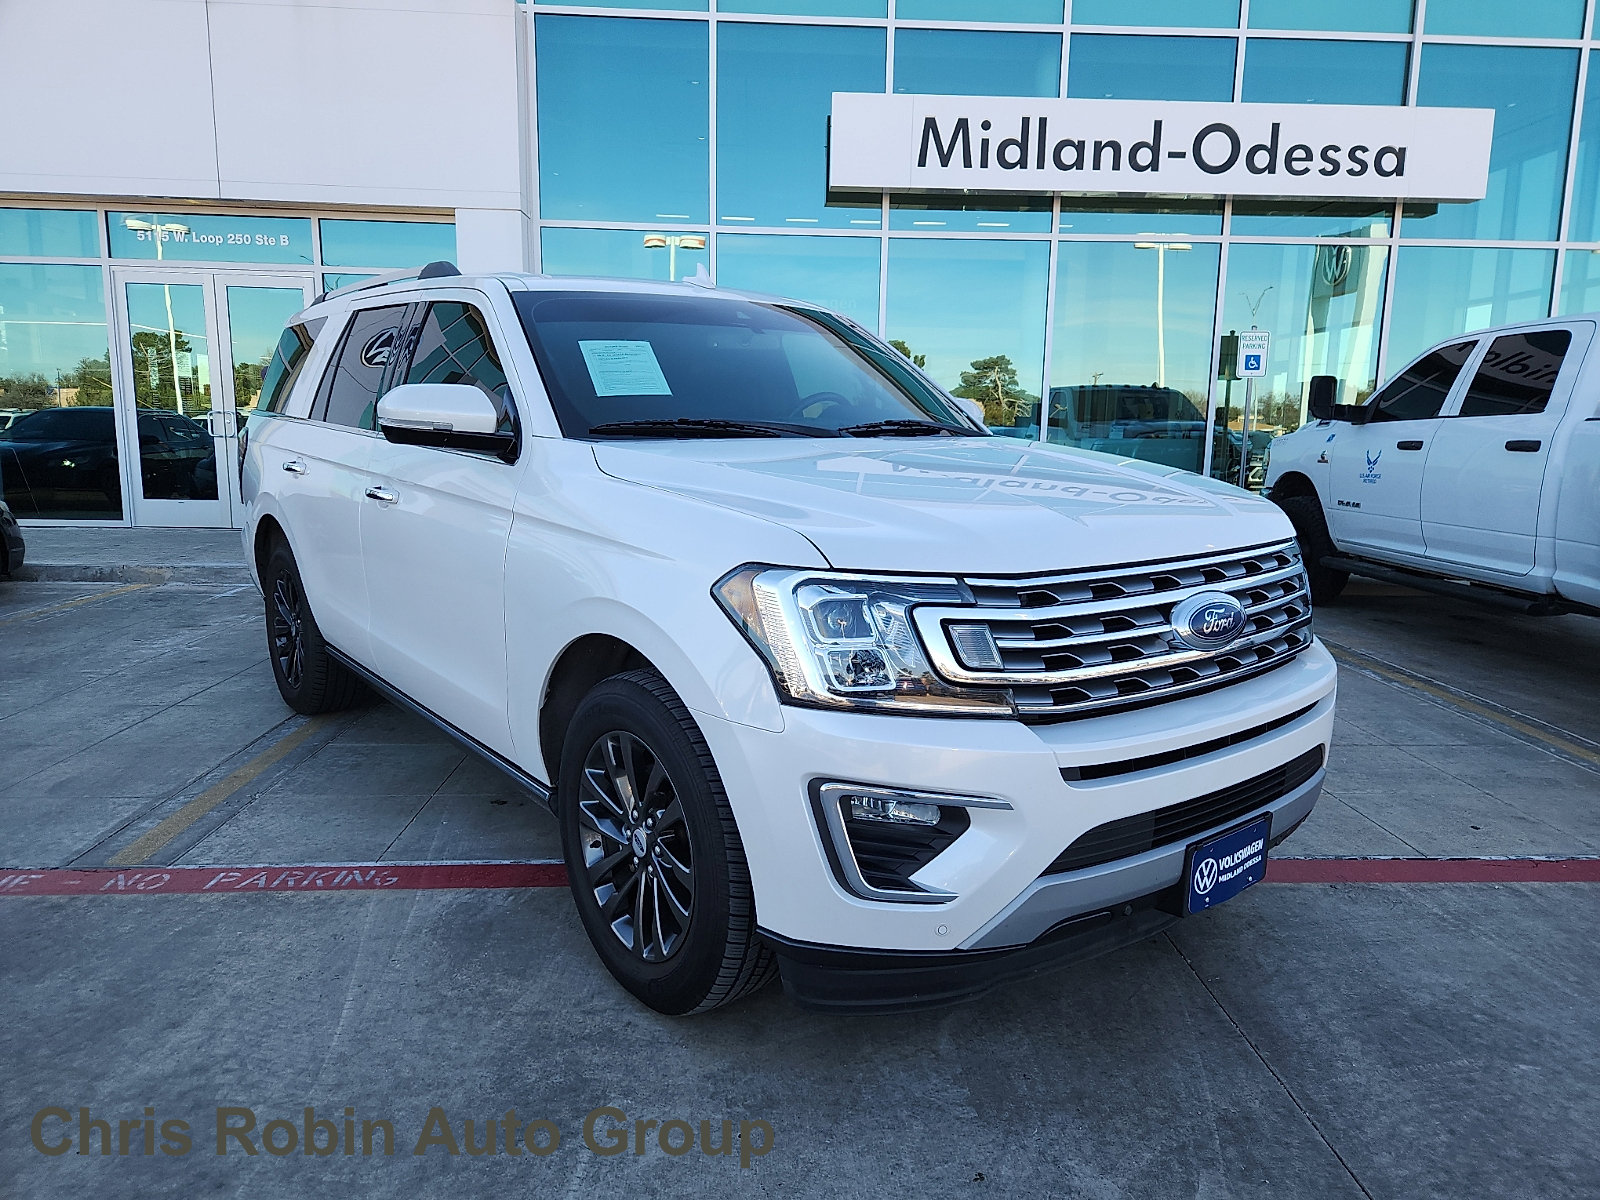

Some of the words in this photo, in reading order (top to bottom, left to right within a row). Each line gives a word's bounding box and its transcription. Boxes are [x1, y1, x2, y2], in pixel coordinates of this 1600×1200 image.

[917, 116, 1407, 178] Midland-Odessa
[192, 232, 223, 246] Loop
[227, 234, 251, 245] 250
[255, 235, 276, 246] Ste
[280, 236, 289, 246] B
[1203, 608, 1235, 634] Ford
[1219, 838, 1264, 870] VOLKSWAGEN
[100, 873, 171, 891] NO
[203, 869, 398, 890] PARKING
[1218, 865, 1244, 883] MIDLAND
[1243, 855, 1262, 871] ODESSA
